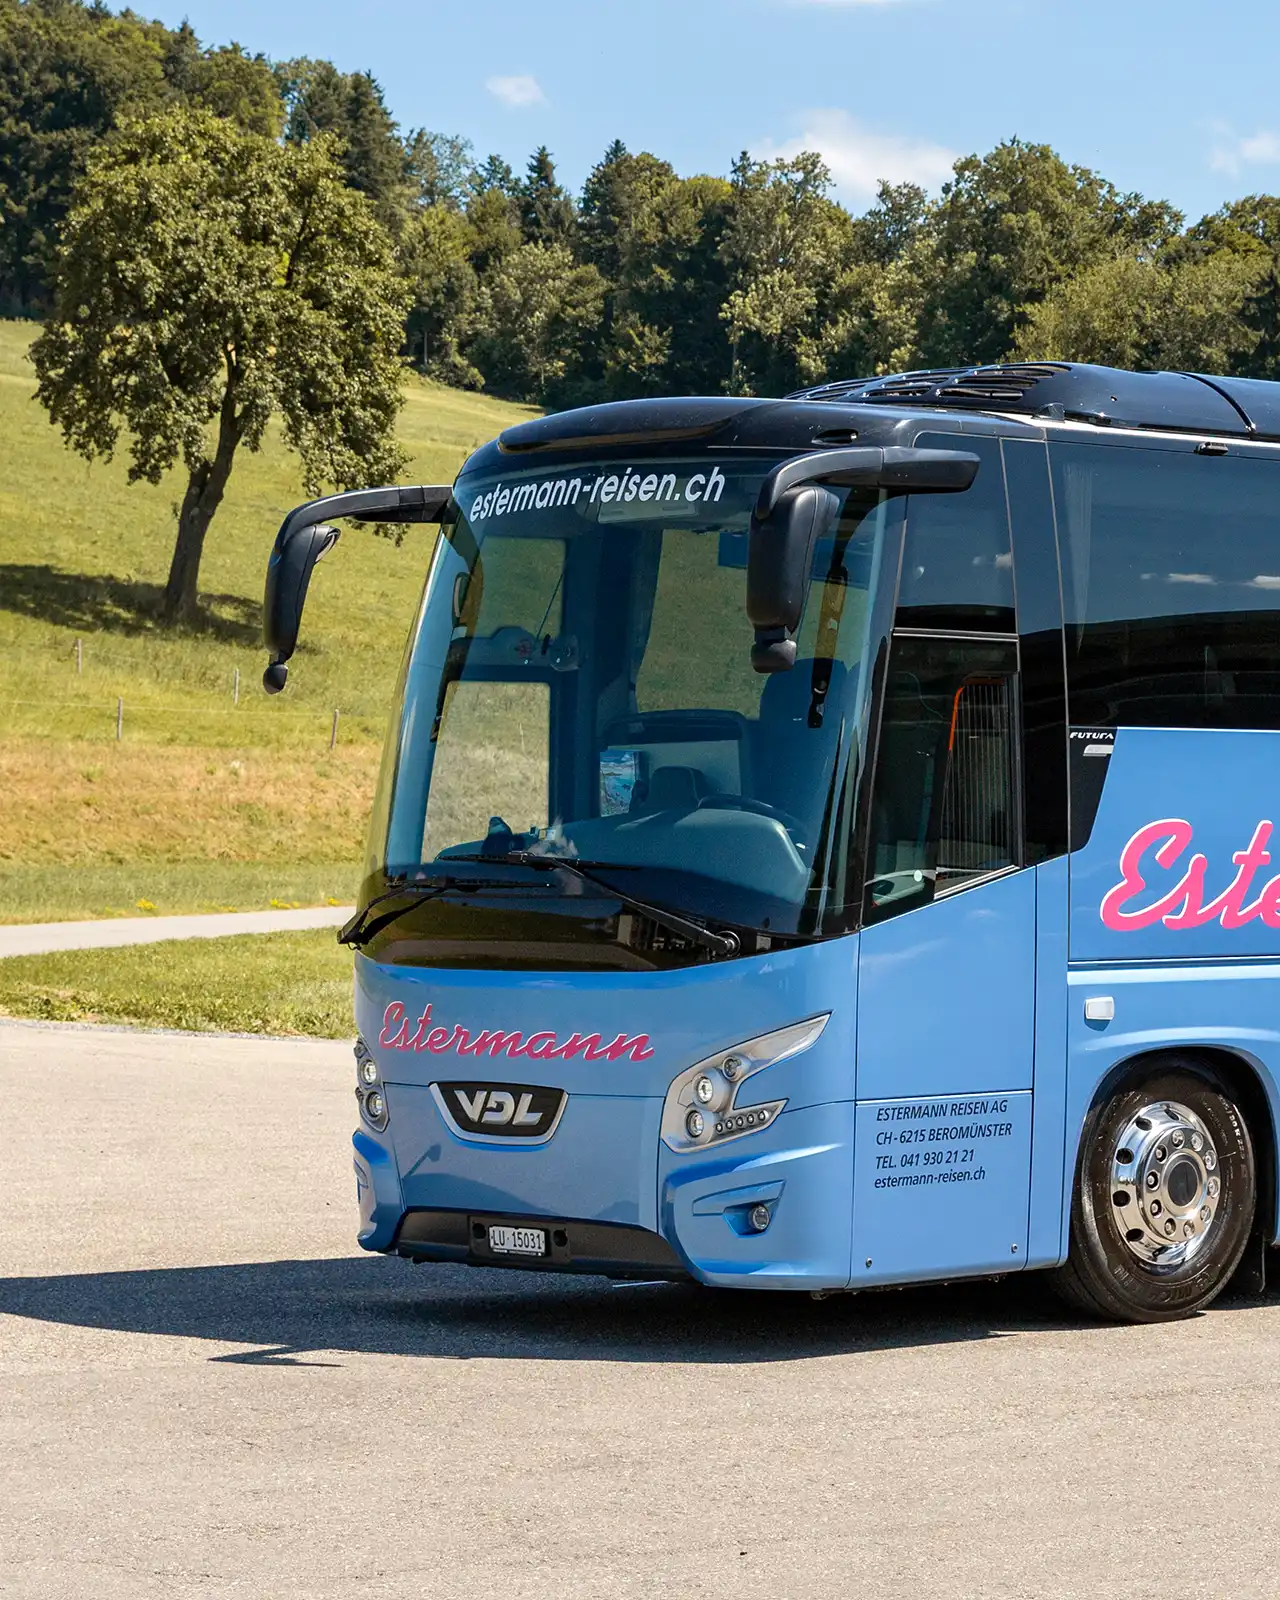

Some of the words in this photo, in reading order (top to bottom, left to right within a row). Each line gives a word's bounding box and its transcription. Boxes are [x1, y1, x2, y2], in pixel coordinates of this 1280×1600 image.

[469, 466, 725, 523] estermann-reisen.ch
[1069, 731, 1114, 740] FUTURA
[379, 1001, 655, 1062] Estermann
[453, 1090, 543, 1126] VDL
[876, 1103, 948, 1122] ESTERMANN
[950, 1101, 989, 1116] REISEN
[990, 1099, 1008, 1113] AG
[899, 1128, 926, 1144] 6215
[928, 1122, 1012, 1141] BEROMÜNSTER
[876, 1155, 897, 1169] TEL.
[900, 1153, 919, 1167] 041
[923, 1151, 943, 1166] 930
[945, 1150, 959, 1164] 21
[961, 1149, 975, 1162] 21
[874, 1166, 986, 1188] estermann-reisen.ch
[512, 1231, 542, 1249] 15031
